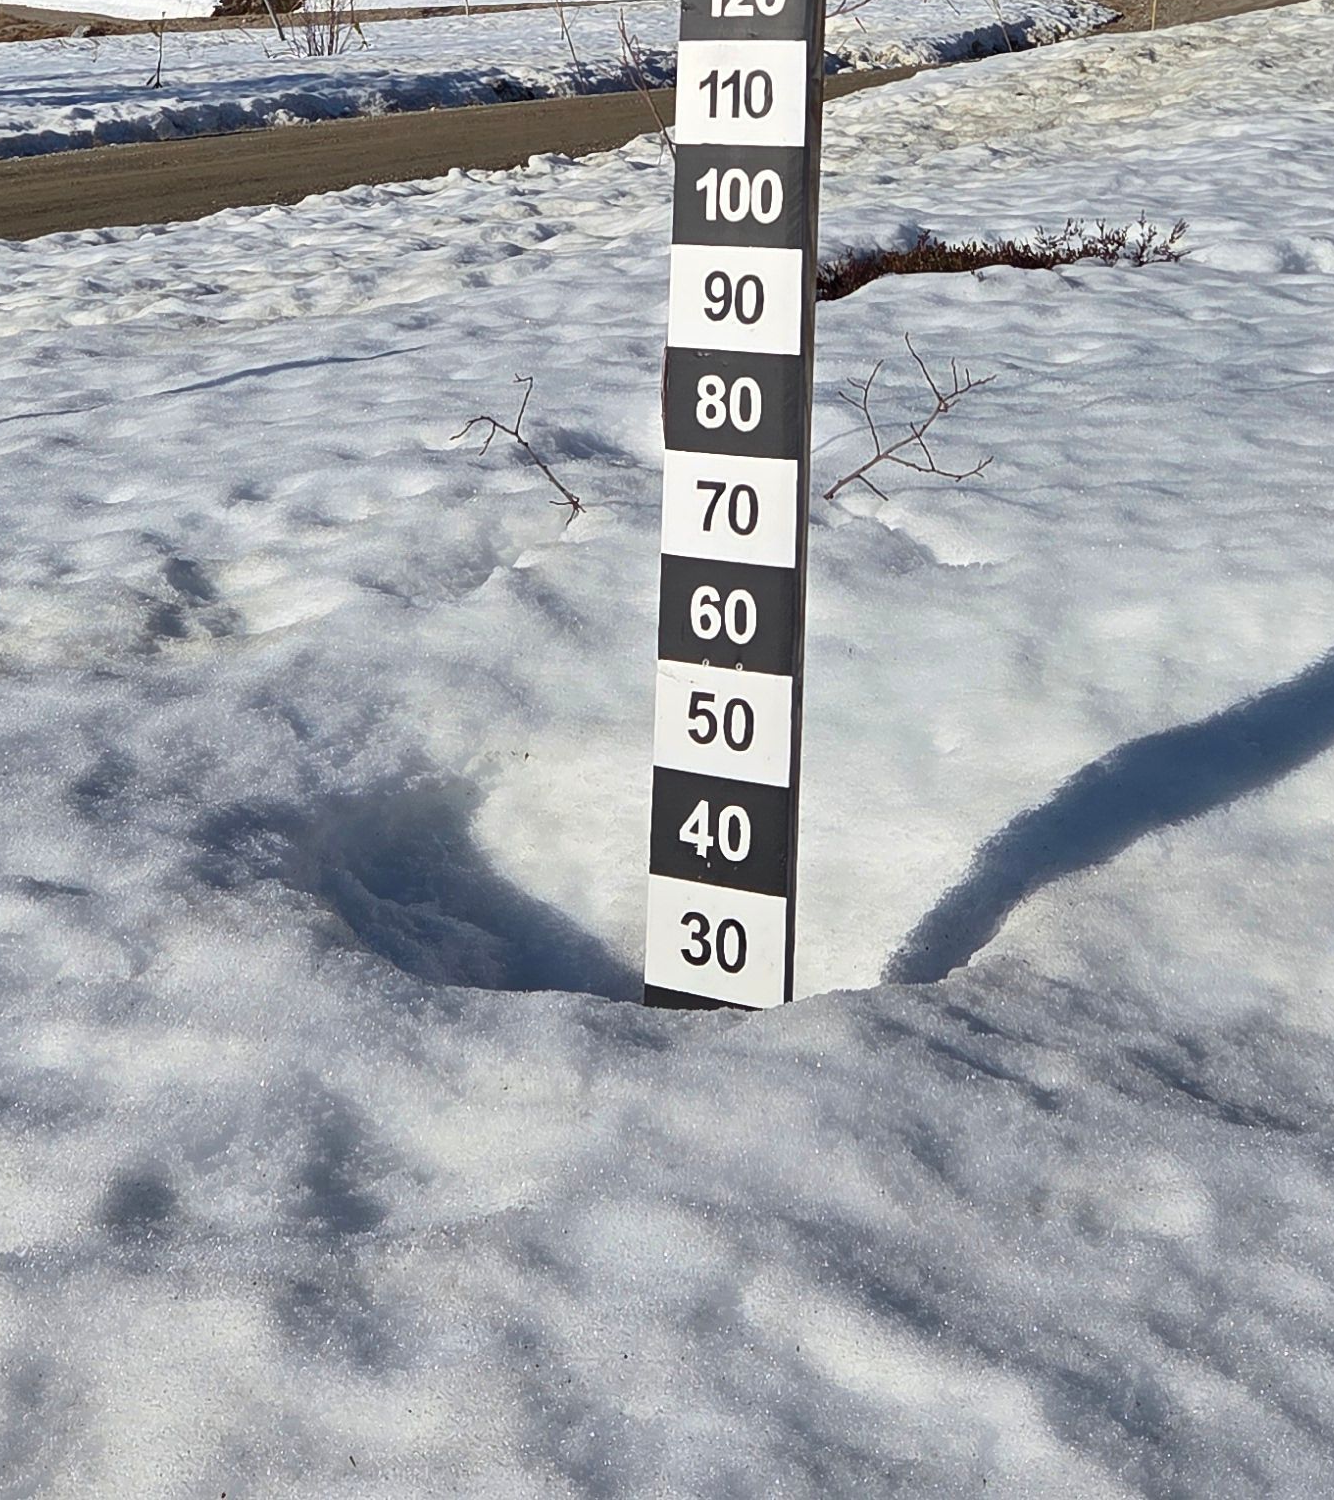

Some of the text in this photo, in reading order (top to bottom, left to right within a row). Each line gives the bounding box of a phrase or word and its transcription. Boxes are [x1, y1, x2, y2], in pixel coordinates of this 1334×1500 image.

[699, 69, 773, 119] 110
[695, 167, 783, 225] 100
[703, 270, 765, 325] 90
[695, 374, 762, 432] 80
[696, 480, 759, 536] 70
[690, 585, 757, 645] 60
[687, 691, 755, 752] 50
[679, 799, 751, 862] 40
[680, 911, 747, 974] 30
